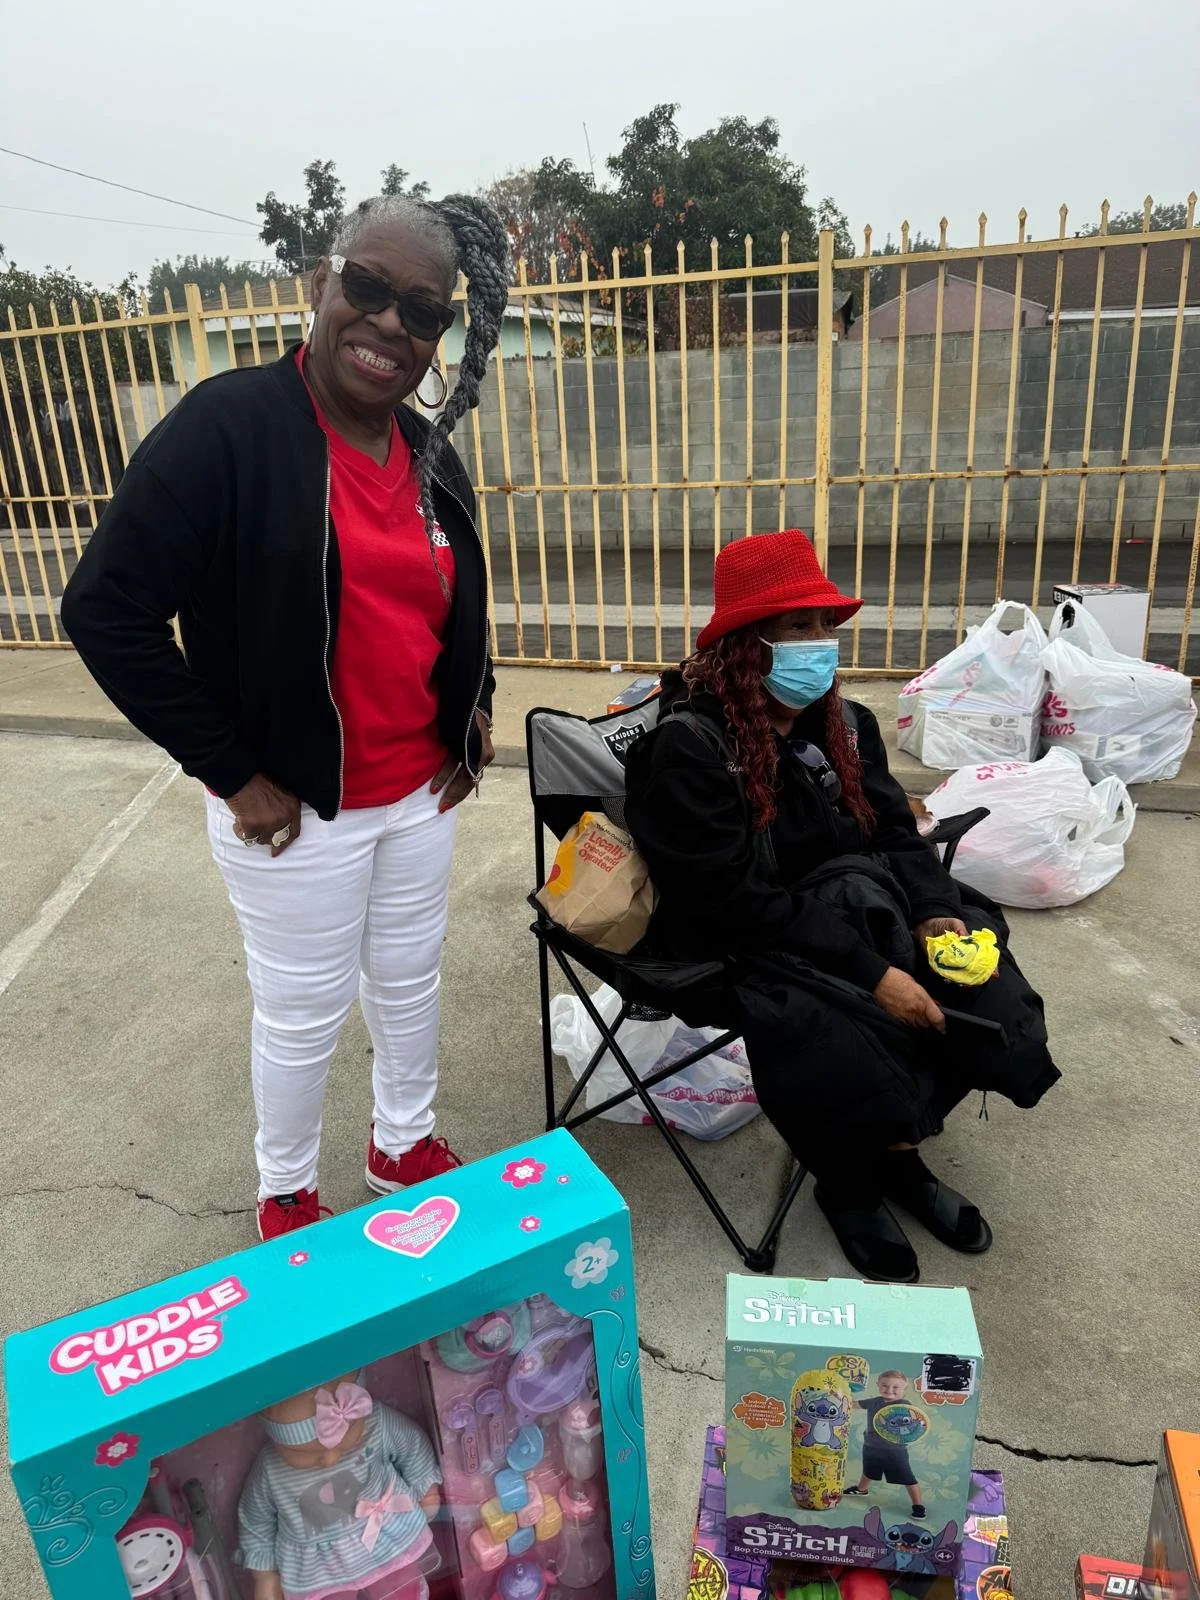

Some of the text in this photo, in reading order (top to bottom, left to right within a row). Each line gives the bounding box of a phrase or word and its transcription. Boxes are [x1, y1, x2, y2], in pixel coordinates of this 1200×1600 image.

[609, 727, 640, 742] RAIDERS
[582, 1256, 602, 1274] 2+
[57, 1281, 242, 1368] CUDDLE
[102, 1325, 218, 1391] KIDS
[767, 1521, 797, 1533] Disney
[734, 1545, 855, 1564] Bop Combo Combo culbuto
[938, 1551, 952, 1559] 4+
